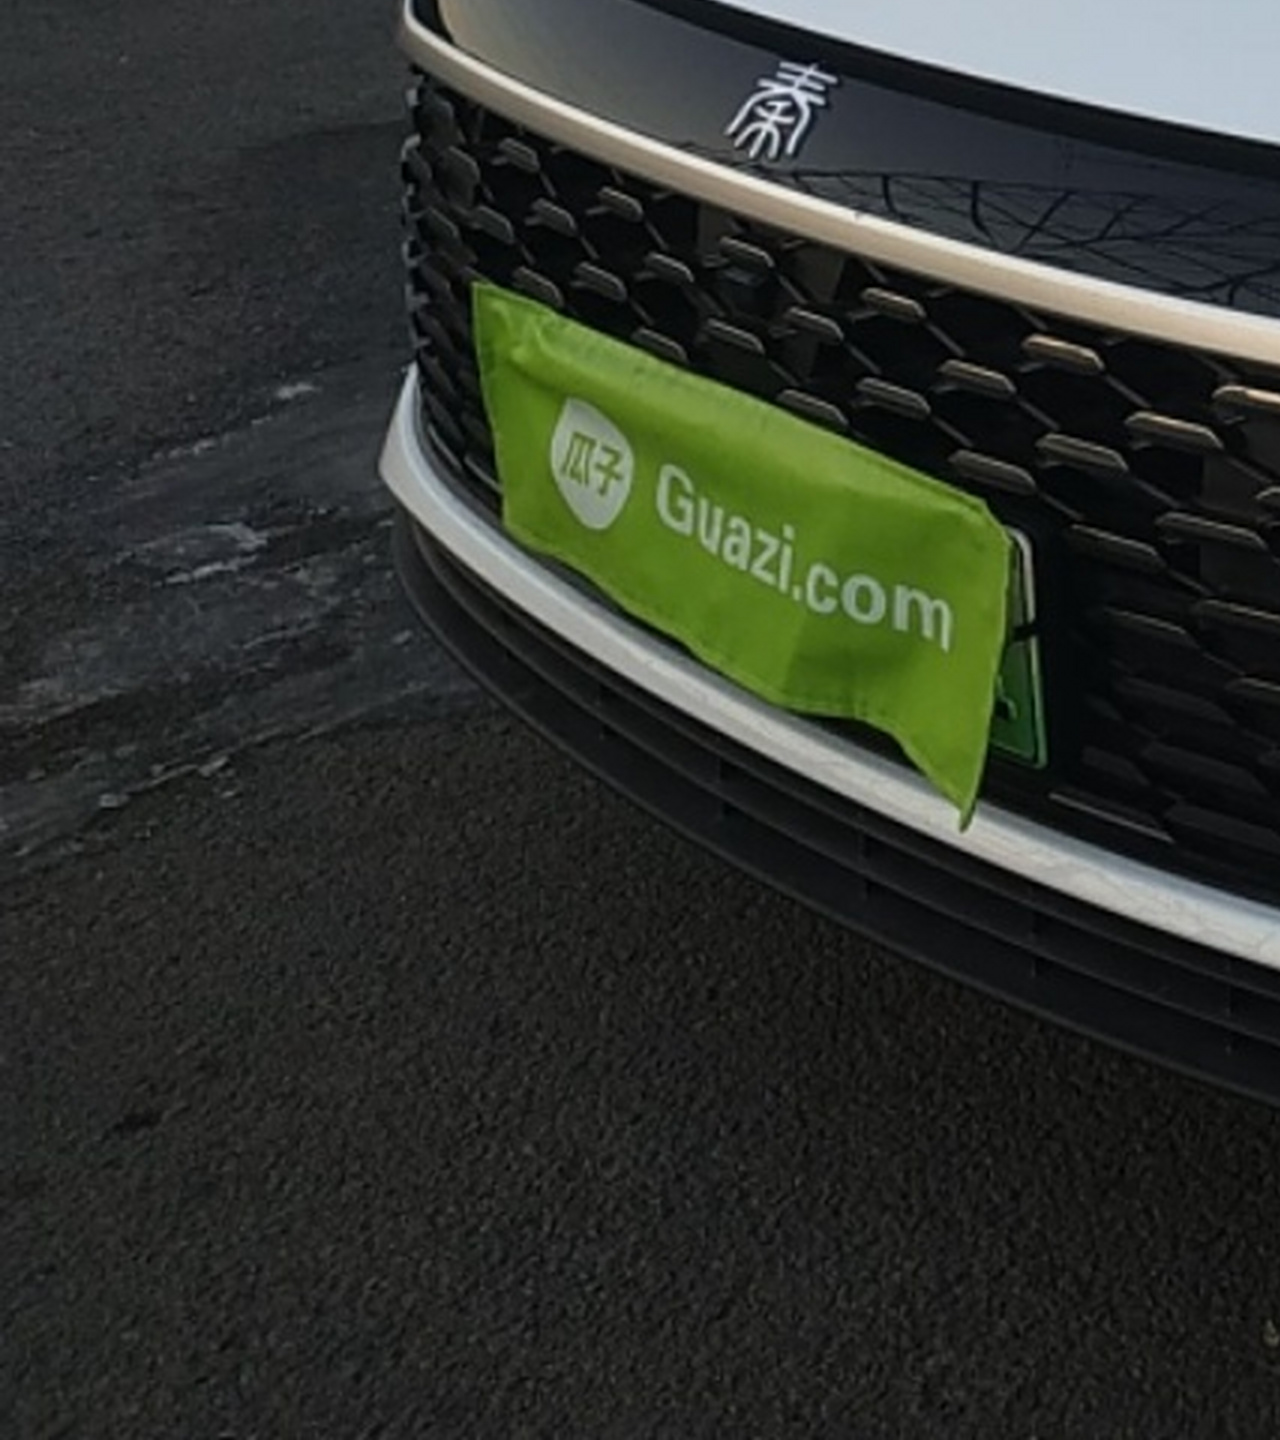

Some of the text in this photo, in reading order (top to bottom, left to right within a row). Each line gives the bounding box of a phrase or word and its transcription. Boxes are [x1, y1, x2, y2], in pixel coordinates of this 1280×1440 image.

[724, 60, 839, 160] 秦
[563, 430, 625, 497] 瓜子
[655, 463, 954, 653] Guazi.com
